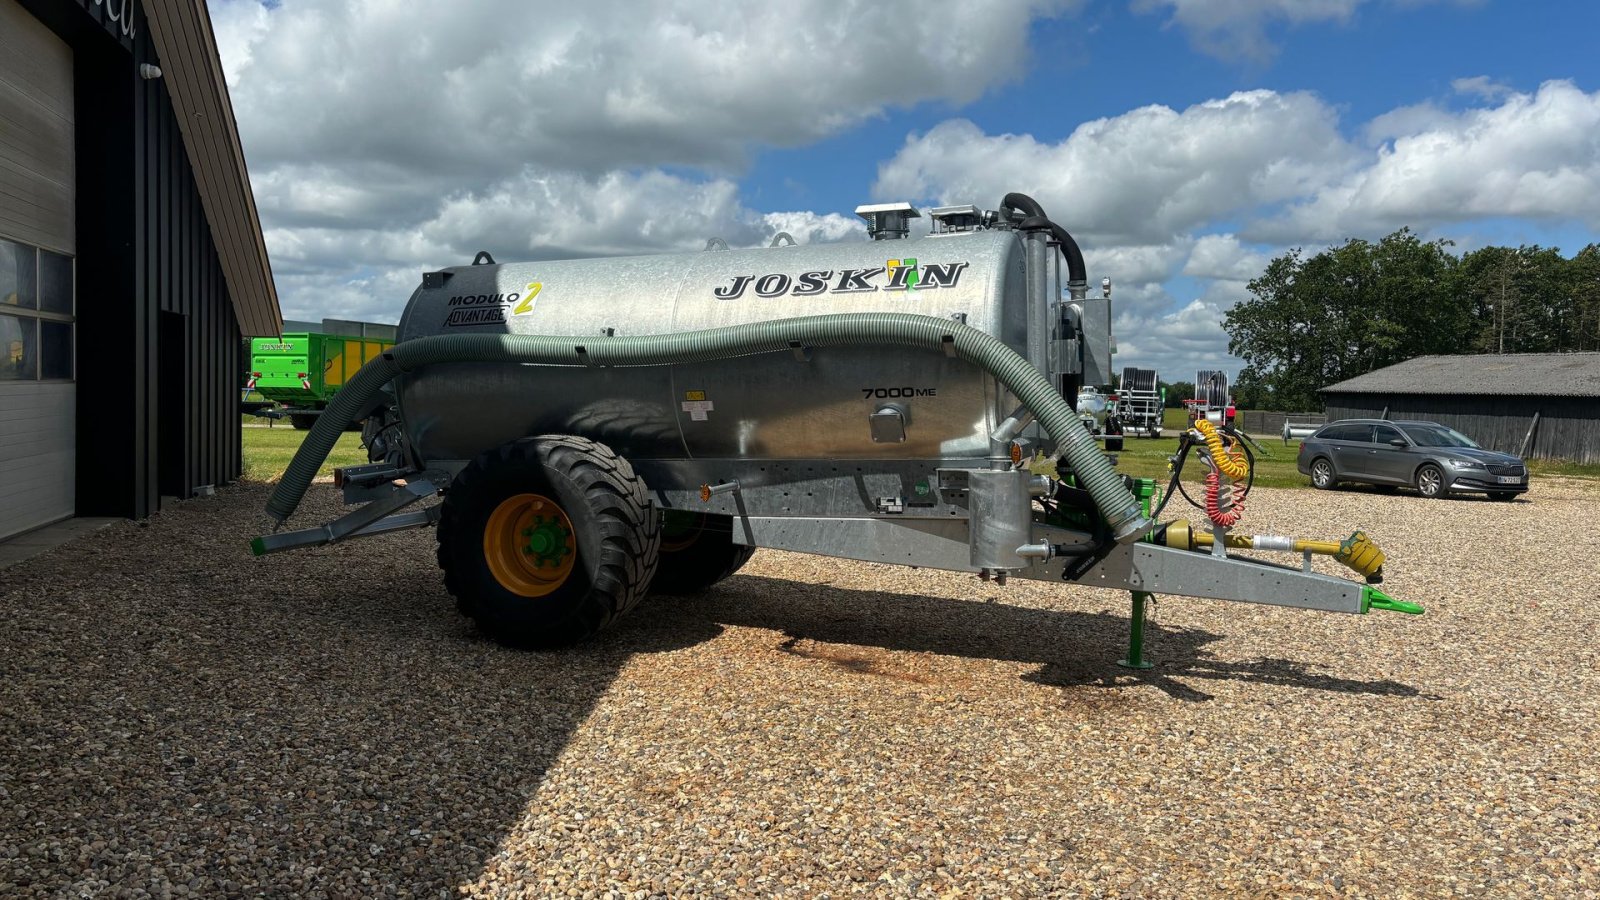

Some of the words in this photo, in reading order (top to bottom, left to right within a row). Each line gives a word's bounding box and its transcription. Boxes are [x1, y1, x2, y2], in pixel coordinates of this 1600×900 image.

[714, 261, 969, 300] JOSKIN
[448, 293, 520, 306] MODULO
[514, 282, 542, 314] 2
[443, 307, 507, 327] ADVANTAGE
